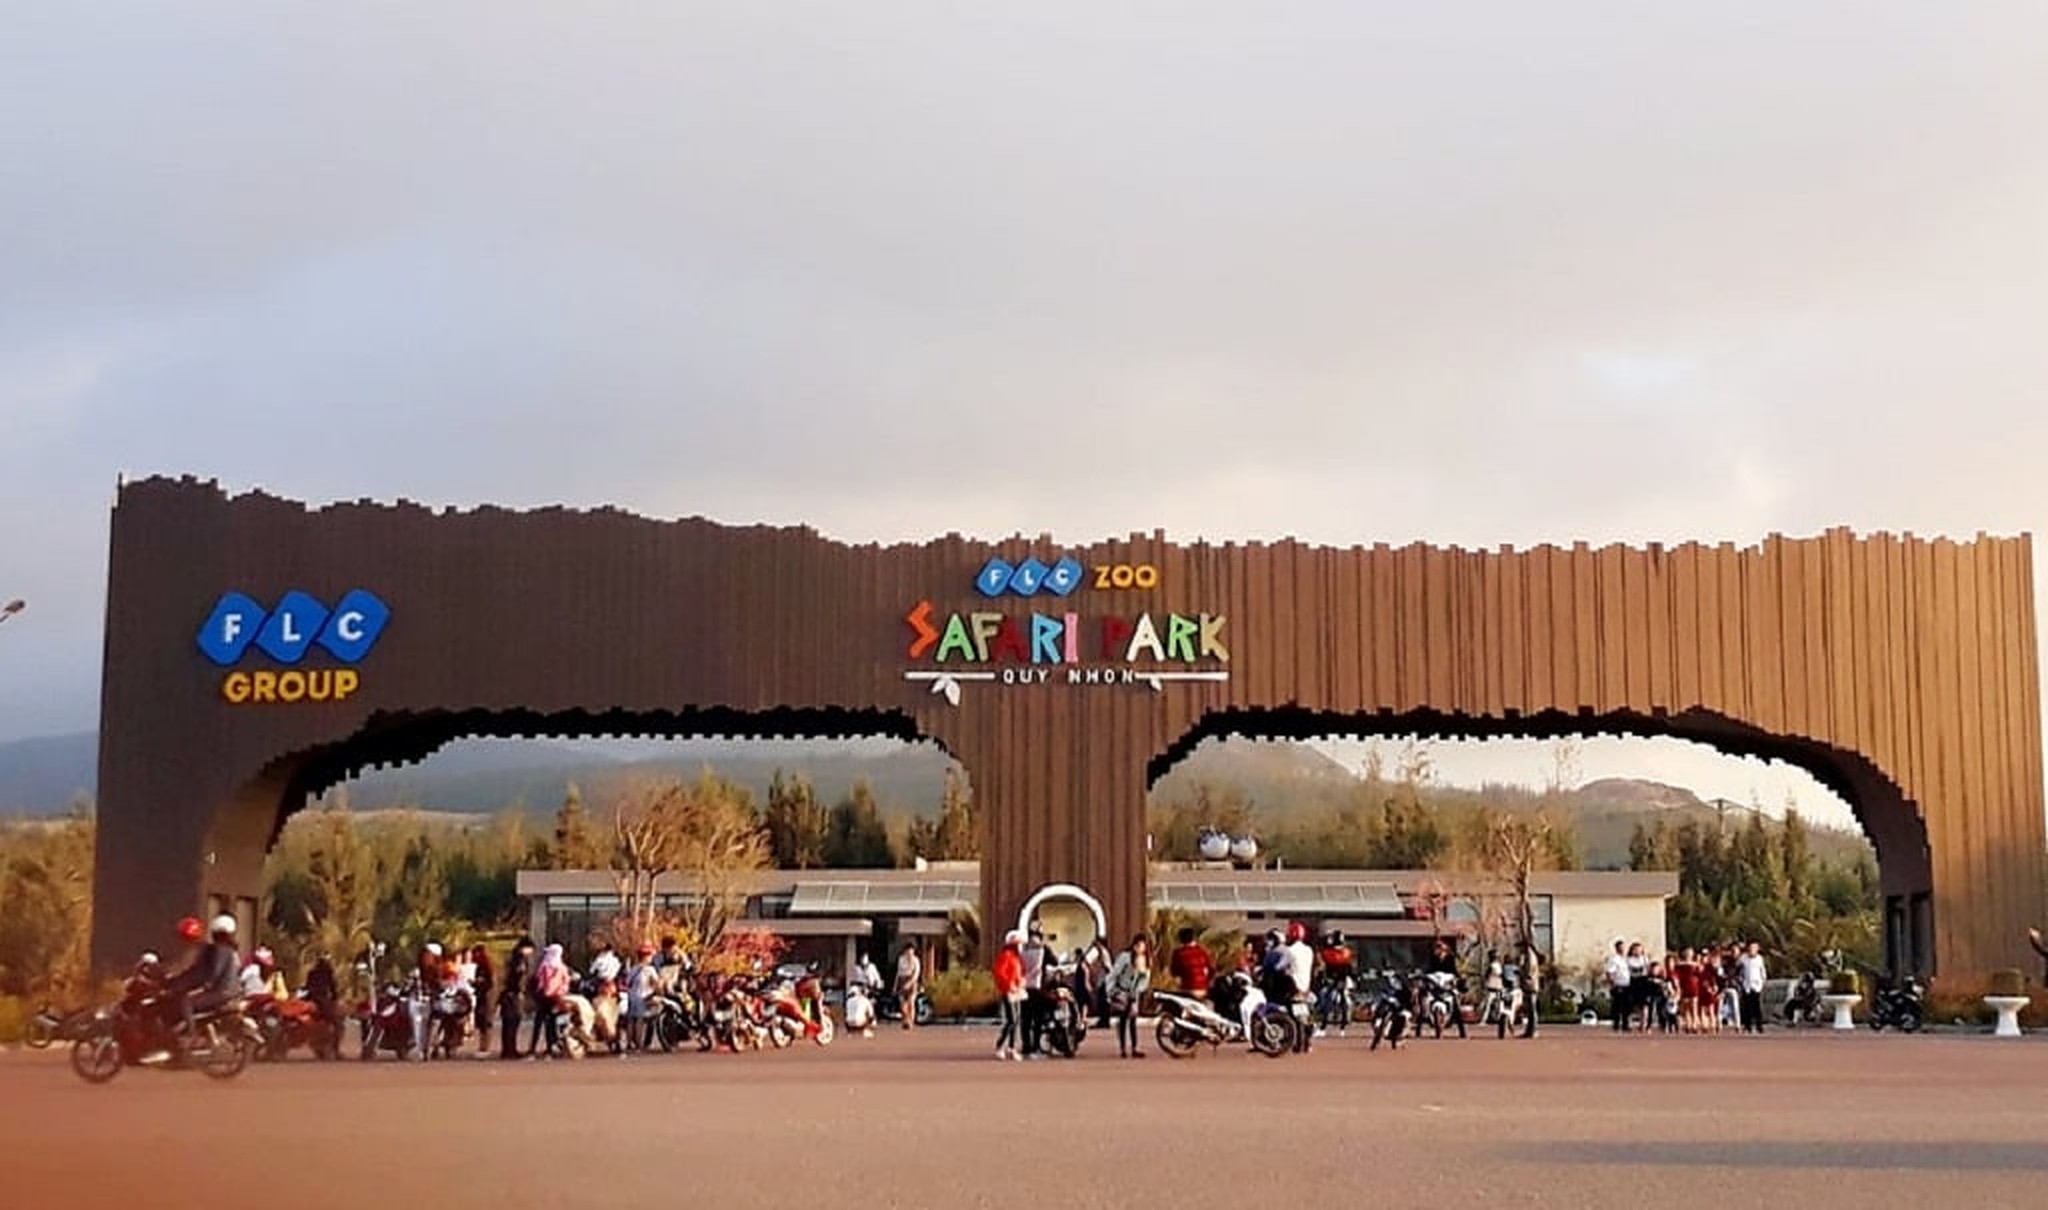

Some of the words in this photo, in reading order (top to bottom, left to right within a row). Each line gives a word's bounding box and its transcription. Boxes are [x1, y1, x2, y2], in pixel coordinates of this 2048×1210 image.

[988, 569, 1069, 586] FLC
[1095, 565, 1158, 589] ZOO
[224, 611, 365, 643] FLC
[906, 600, 1079, 664] SAFARI
[1103, 612, 1229, 664] PARK
[224, 671, 360, 702] GROUP
[1003, 669, 1049, 684] QUY
[1068, 668, 1134, 684] NHON
